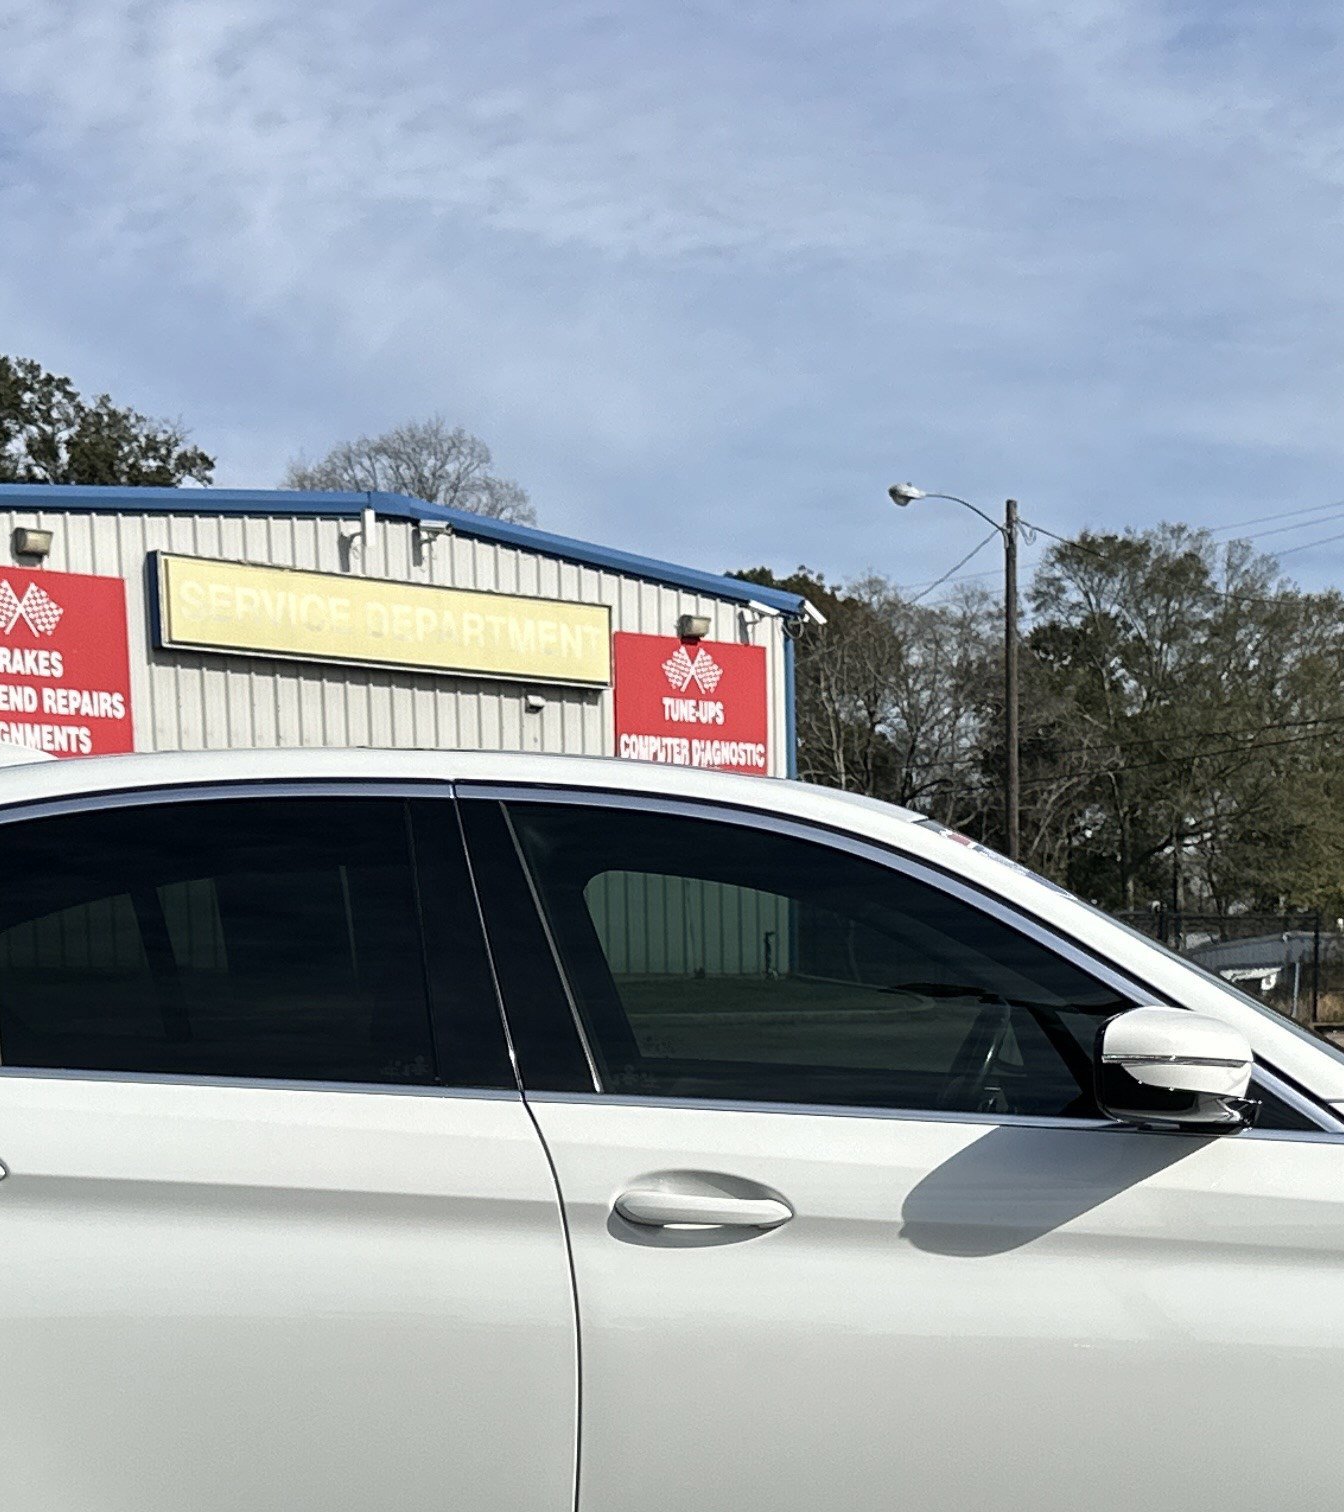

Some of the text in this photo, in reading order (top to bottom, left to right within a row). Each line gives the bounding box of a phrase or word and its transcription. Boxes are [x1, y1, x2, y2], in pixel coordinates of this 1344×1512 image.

[177, 580, 601, 659] SERVICE DEPARTMENT
[42, 687, 125, 719] REPAIRS
[662, 697, 725, 725] TUNE-UPS
[620, 733, 766, 768] COMPUTER DIAGNOSTIC
